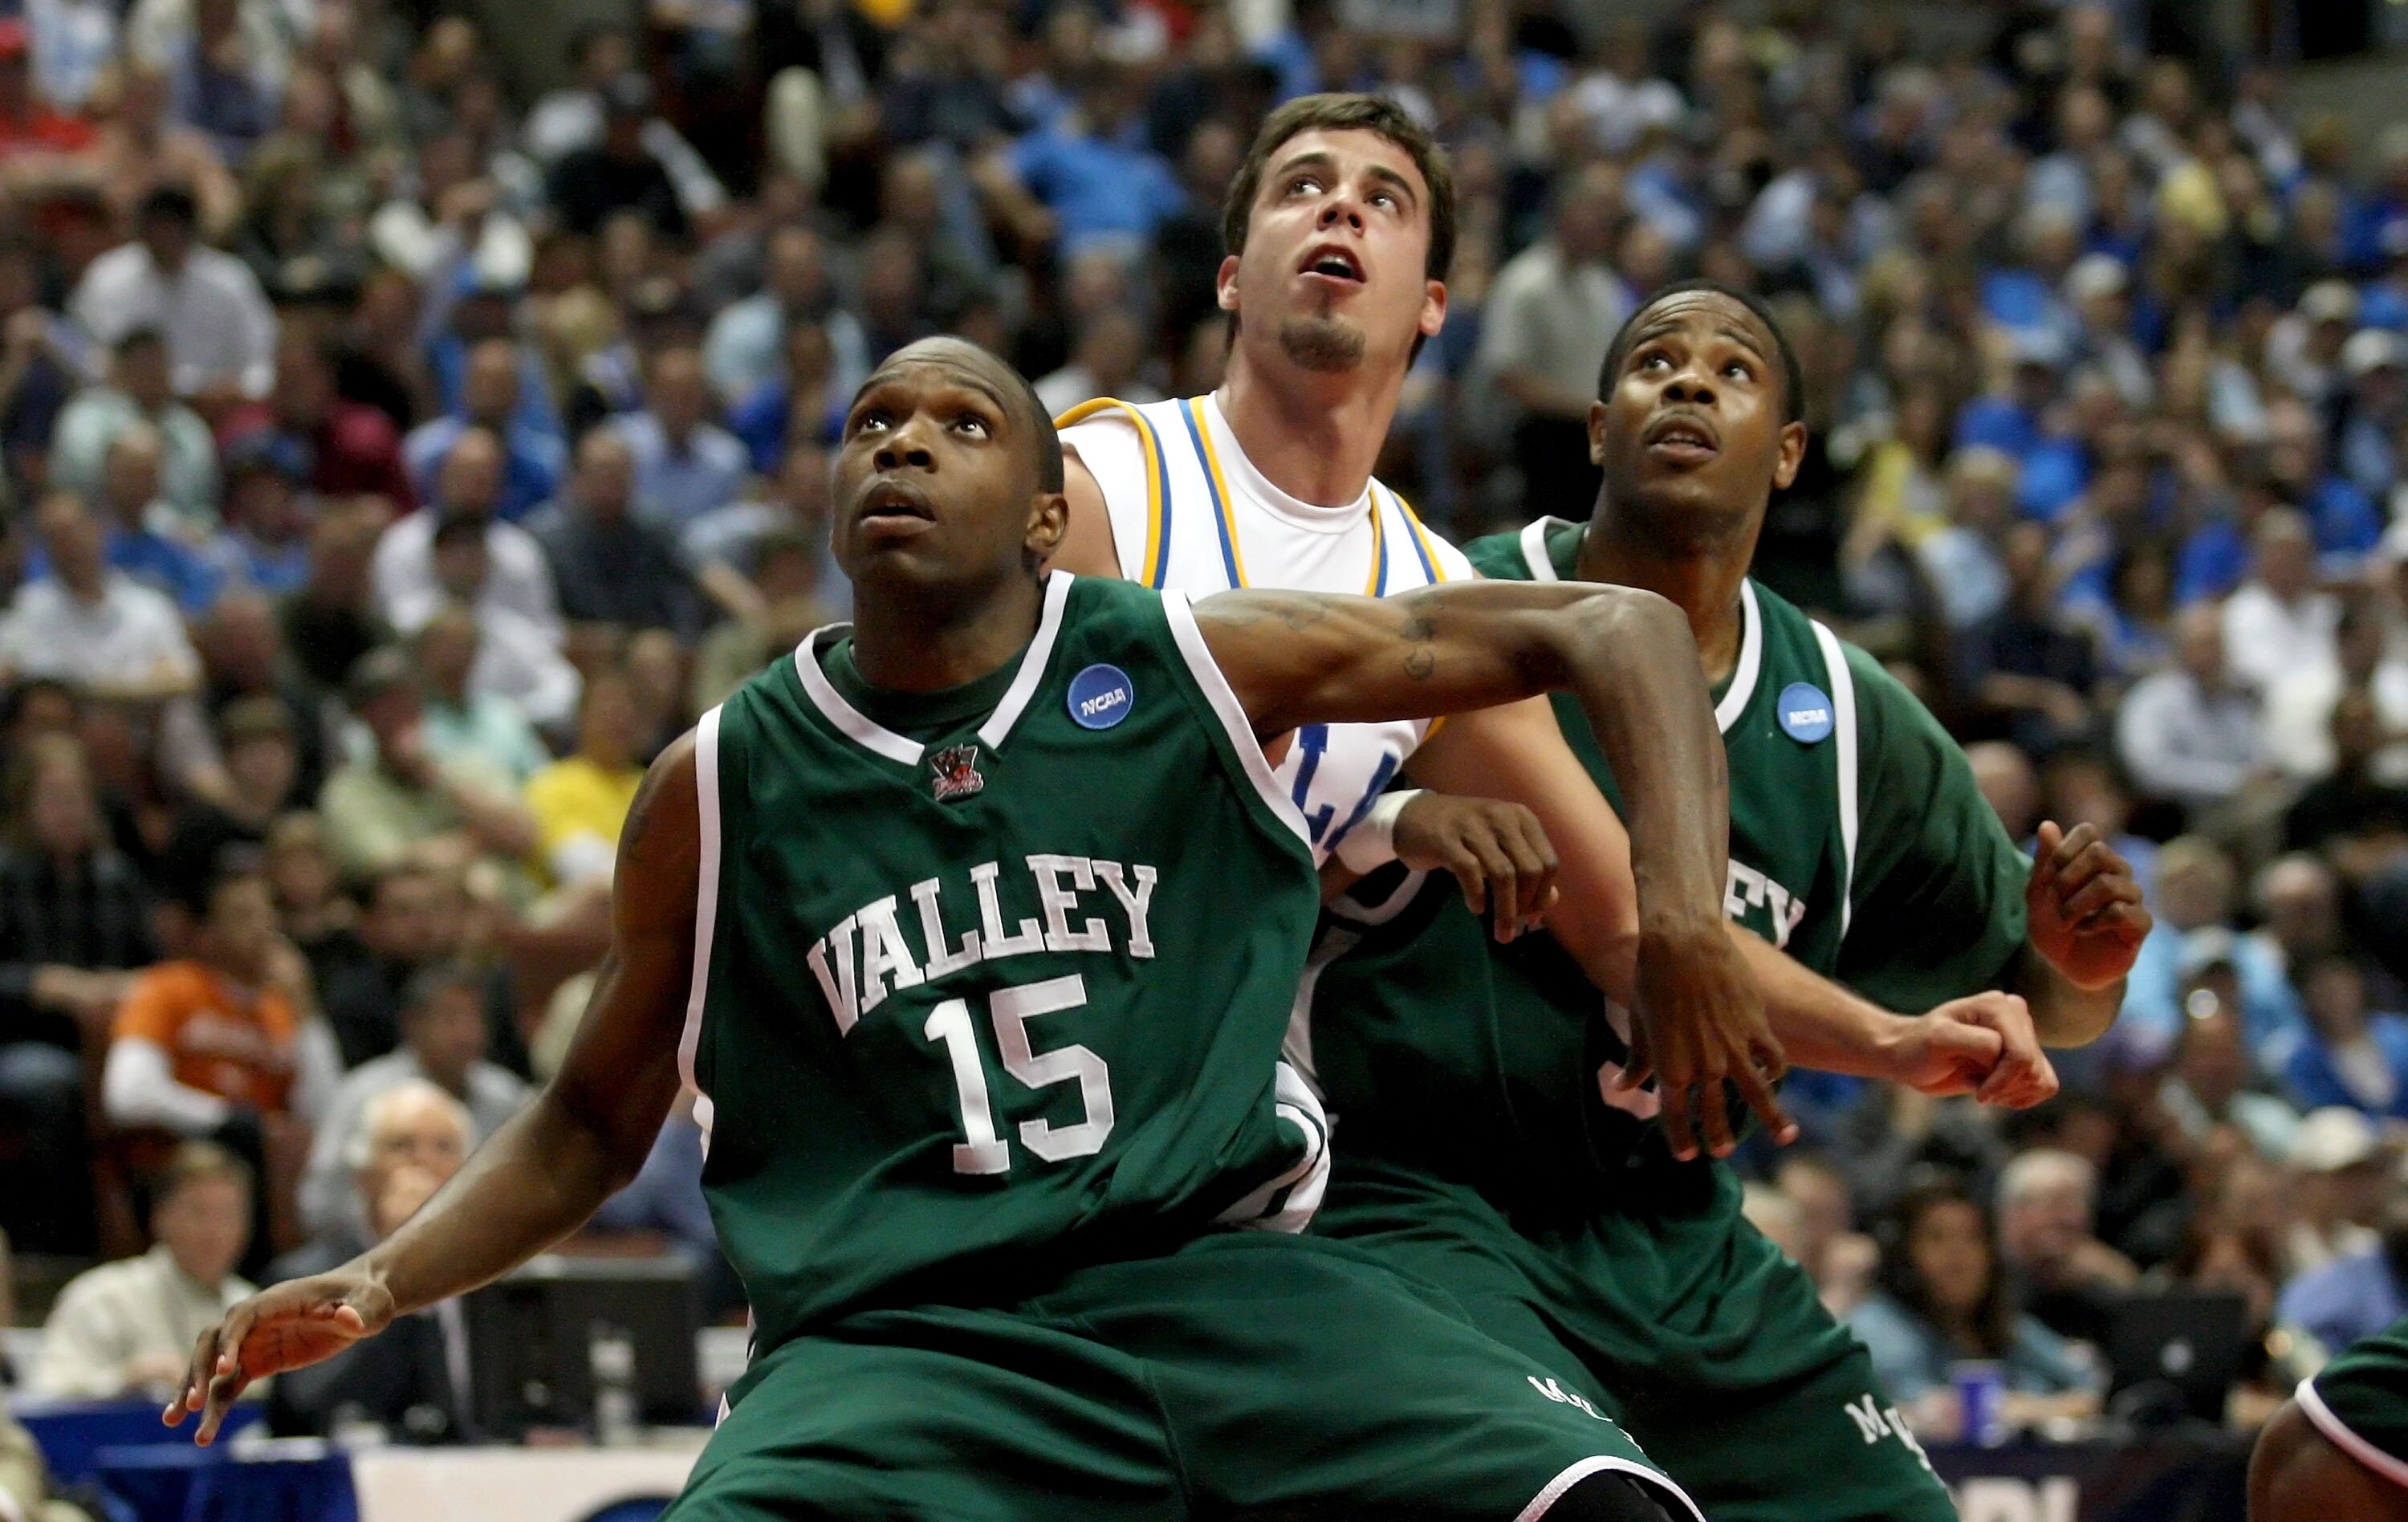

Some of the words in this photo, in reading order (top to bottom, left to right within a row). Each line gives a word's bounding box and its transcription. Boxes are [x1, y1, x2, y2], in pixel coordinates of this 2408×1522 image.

[1080, 687, 1126, 717] NCAA
[1788, 708, 1829, 726] NCAA
[806, 853, 1157, 1038] VALLEY
[924, 973, 1115, 1174] 15
